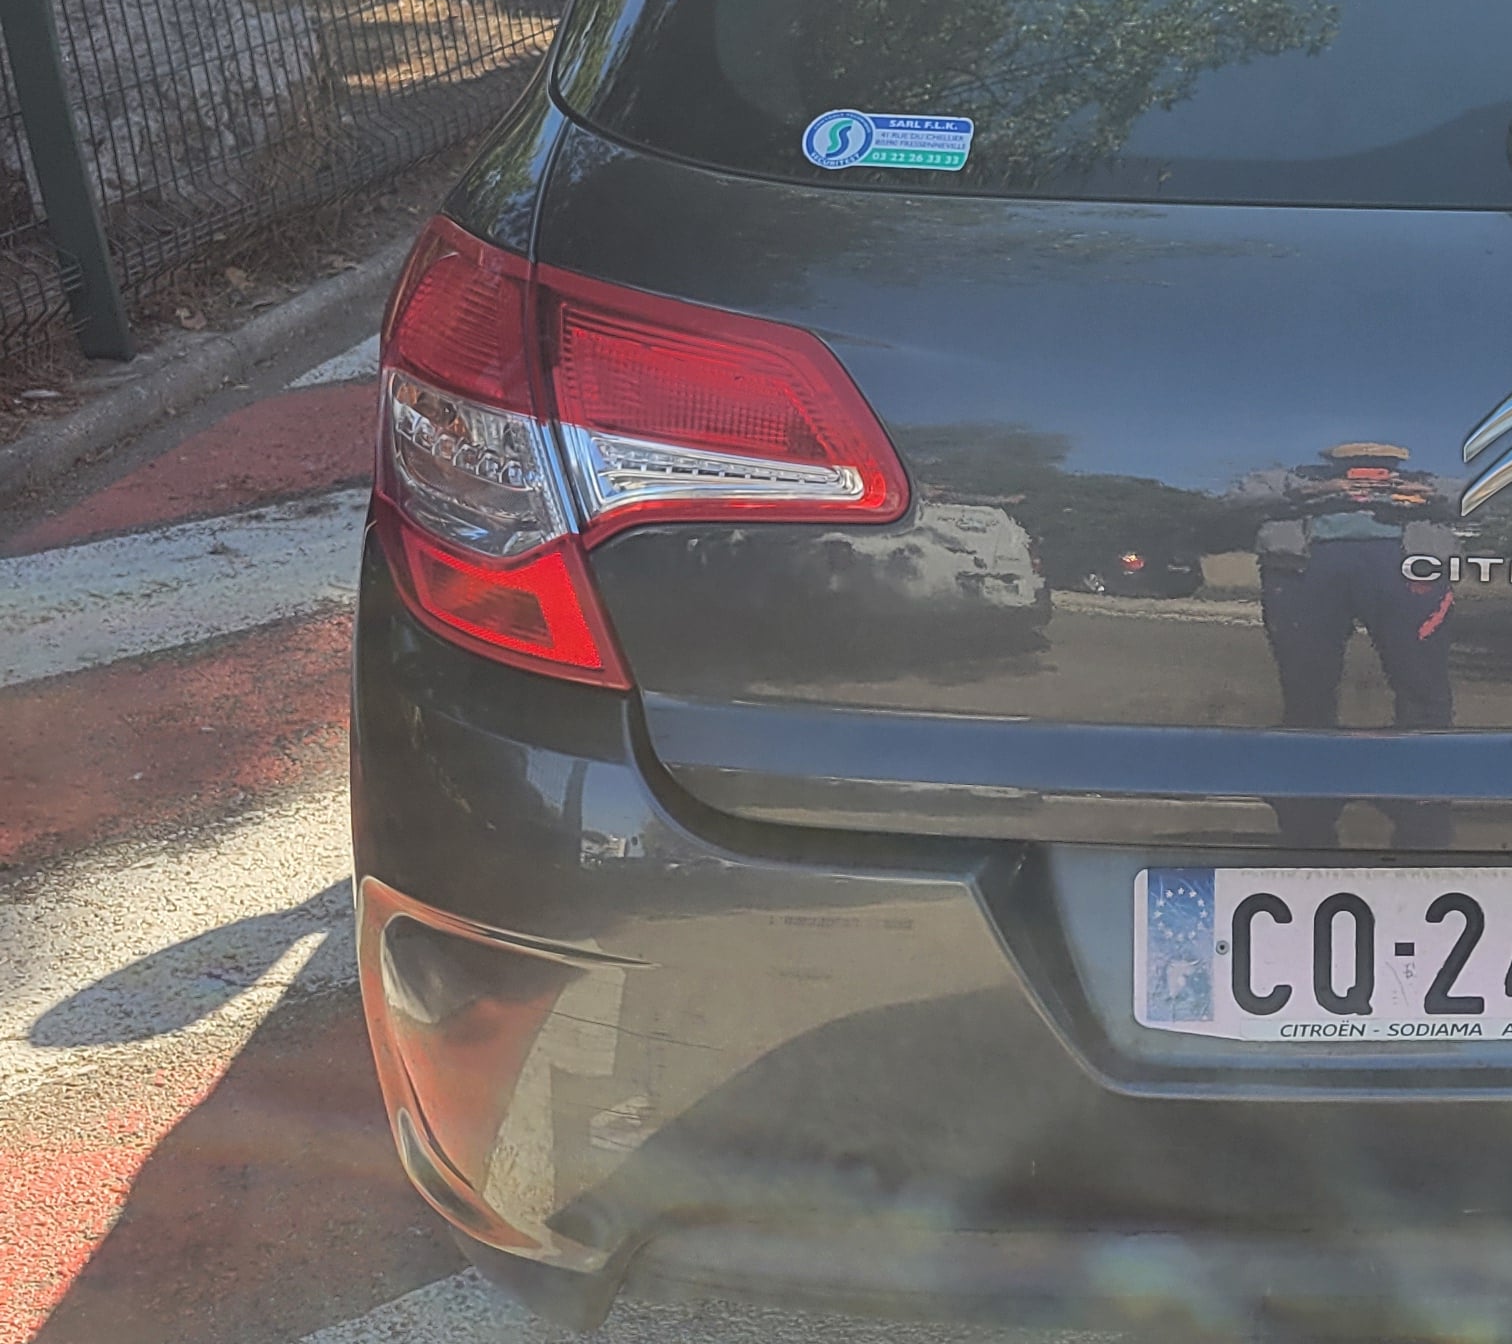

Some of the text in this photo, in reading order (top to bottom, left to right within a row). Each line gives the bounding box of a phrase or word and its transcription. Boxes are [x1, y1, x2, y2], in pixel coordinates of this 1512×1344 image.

[889, 119, 921, 129] SARL
[890, 153, 906, 162] 22
[1280, 1020, 1366, 1037] CITROËN
[1386, 1023, 1483, 1037] SODIAMA
